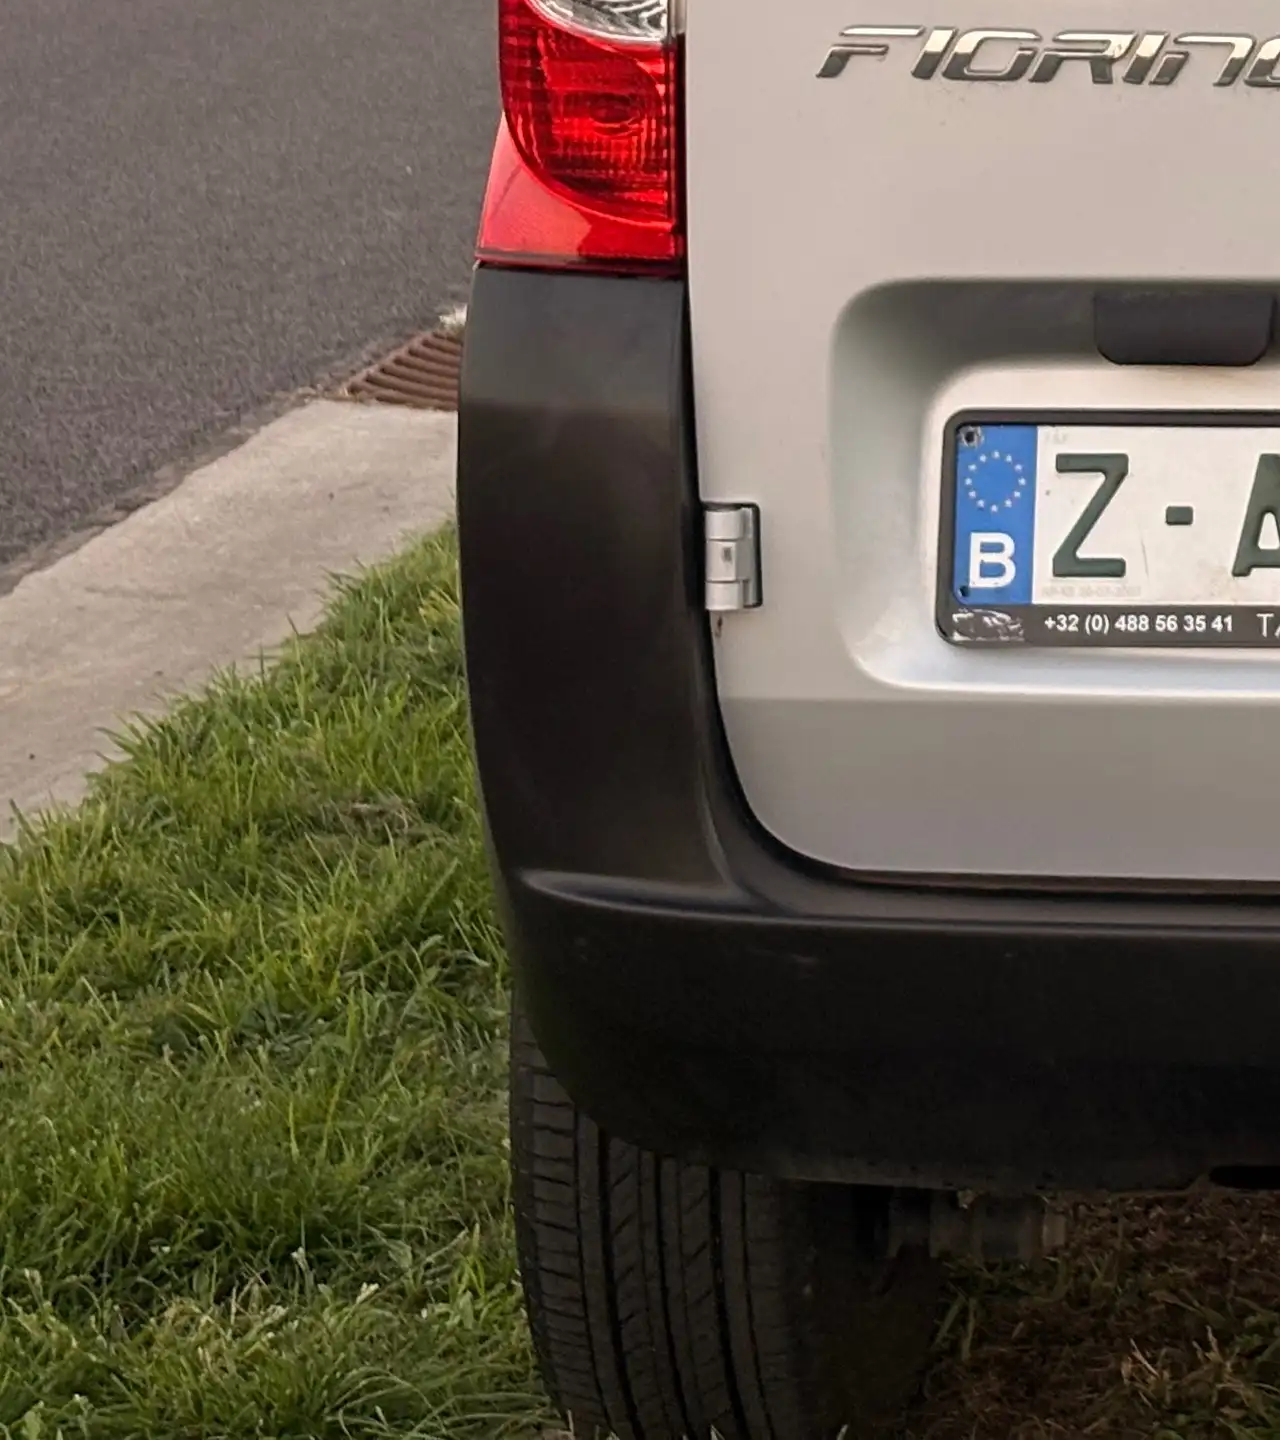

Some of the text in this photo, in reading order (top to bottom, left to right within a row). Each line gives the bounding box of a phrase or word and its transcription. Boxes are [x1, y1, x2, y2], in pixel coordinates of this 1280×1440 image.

[968, 532, 1016, 589] B
[1043, 613, 1234, 636] +32 (0) 488 56 35 41
